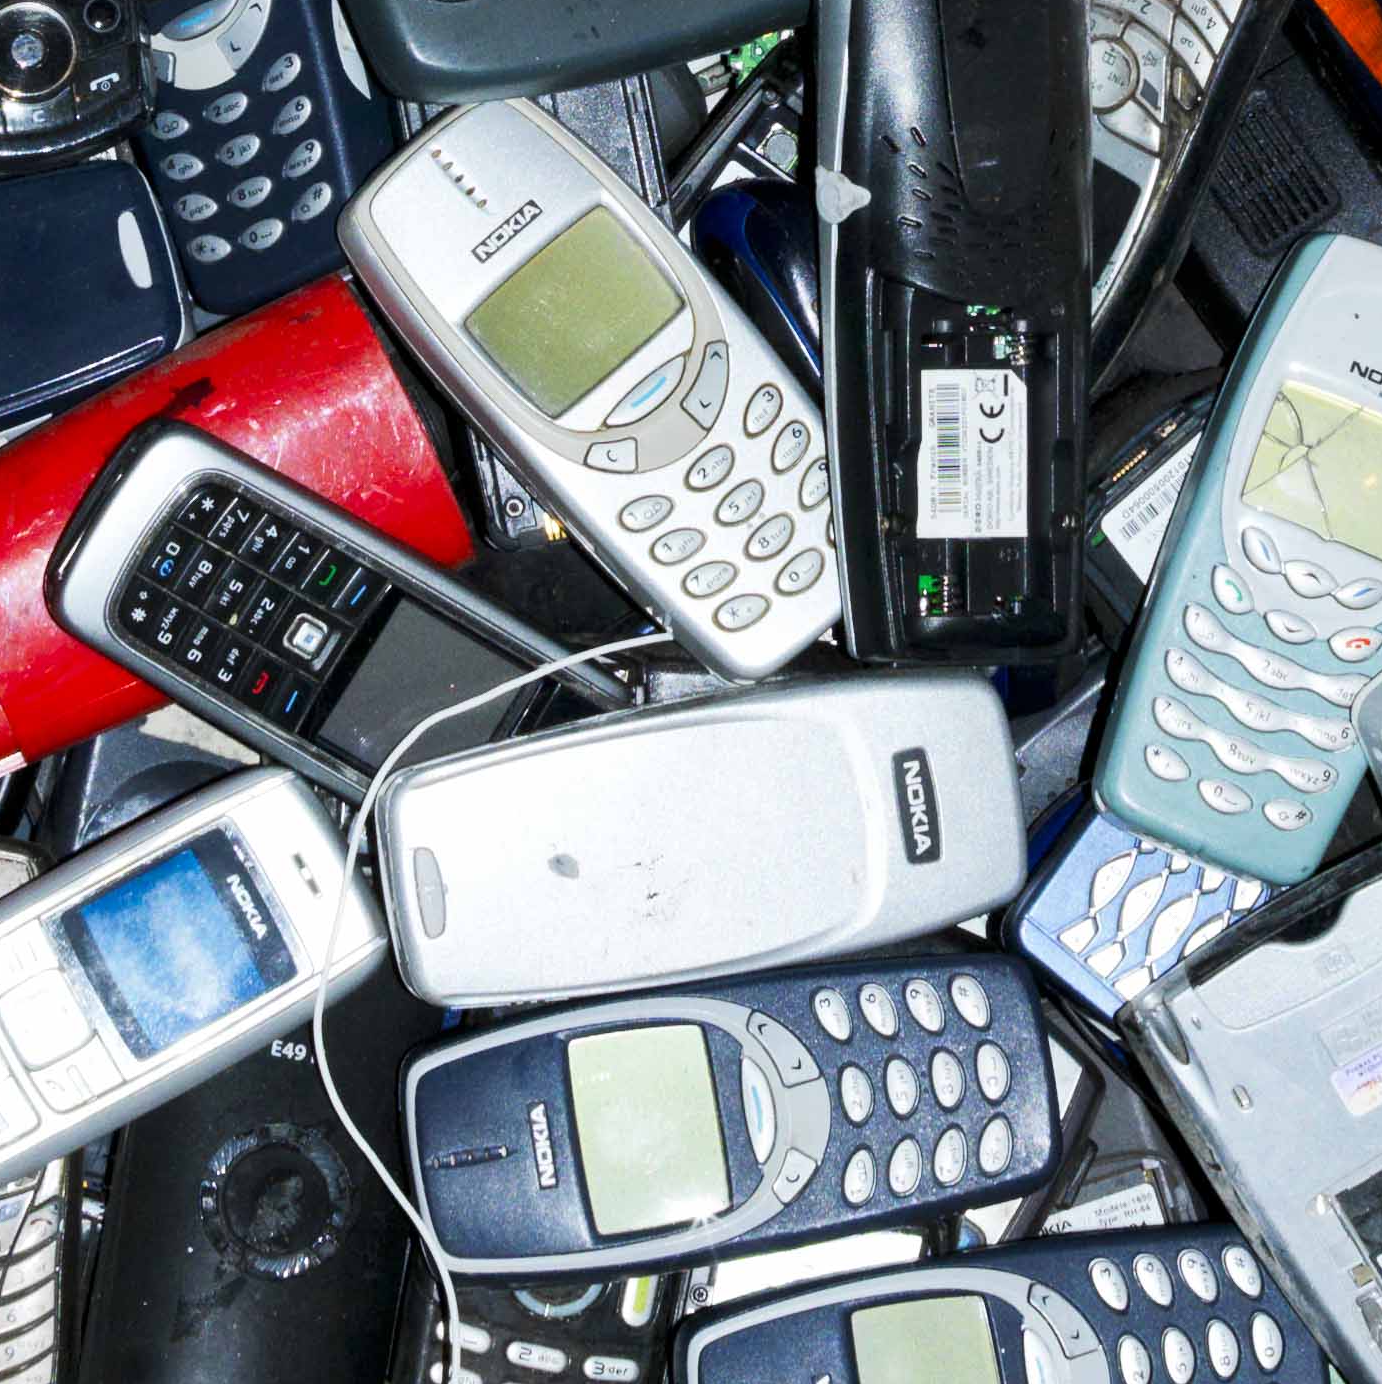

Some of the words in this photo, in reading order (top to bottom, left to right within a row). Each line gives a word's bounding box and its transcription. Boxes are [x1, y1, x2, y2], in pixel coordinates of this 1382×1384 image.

[473, 200, 541, 265] NOKIA
[979, 401, 1004, 443] CE
[900, 759, 933, 856] NOKIA
[225, 873, 268, 941] NOKIA
[529, 1102, 559, 1188] NOKIA
